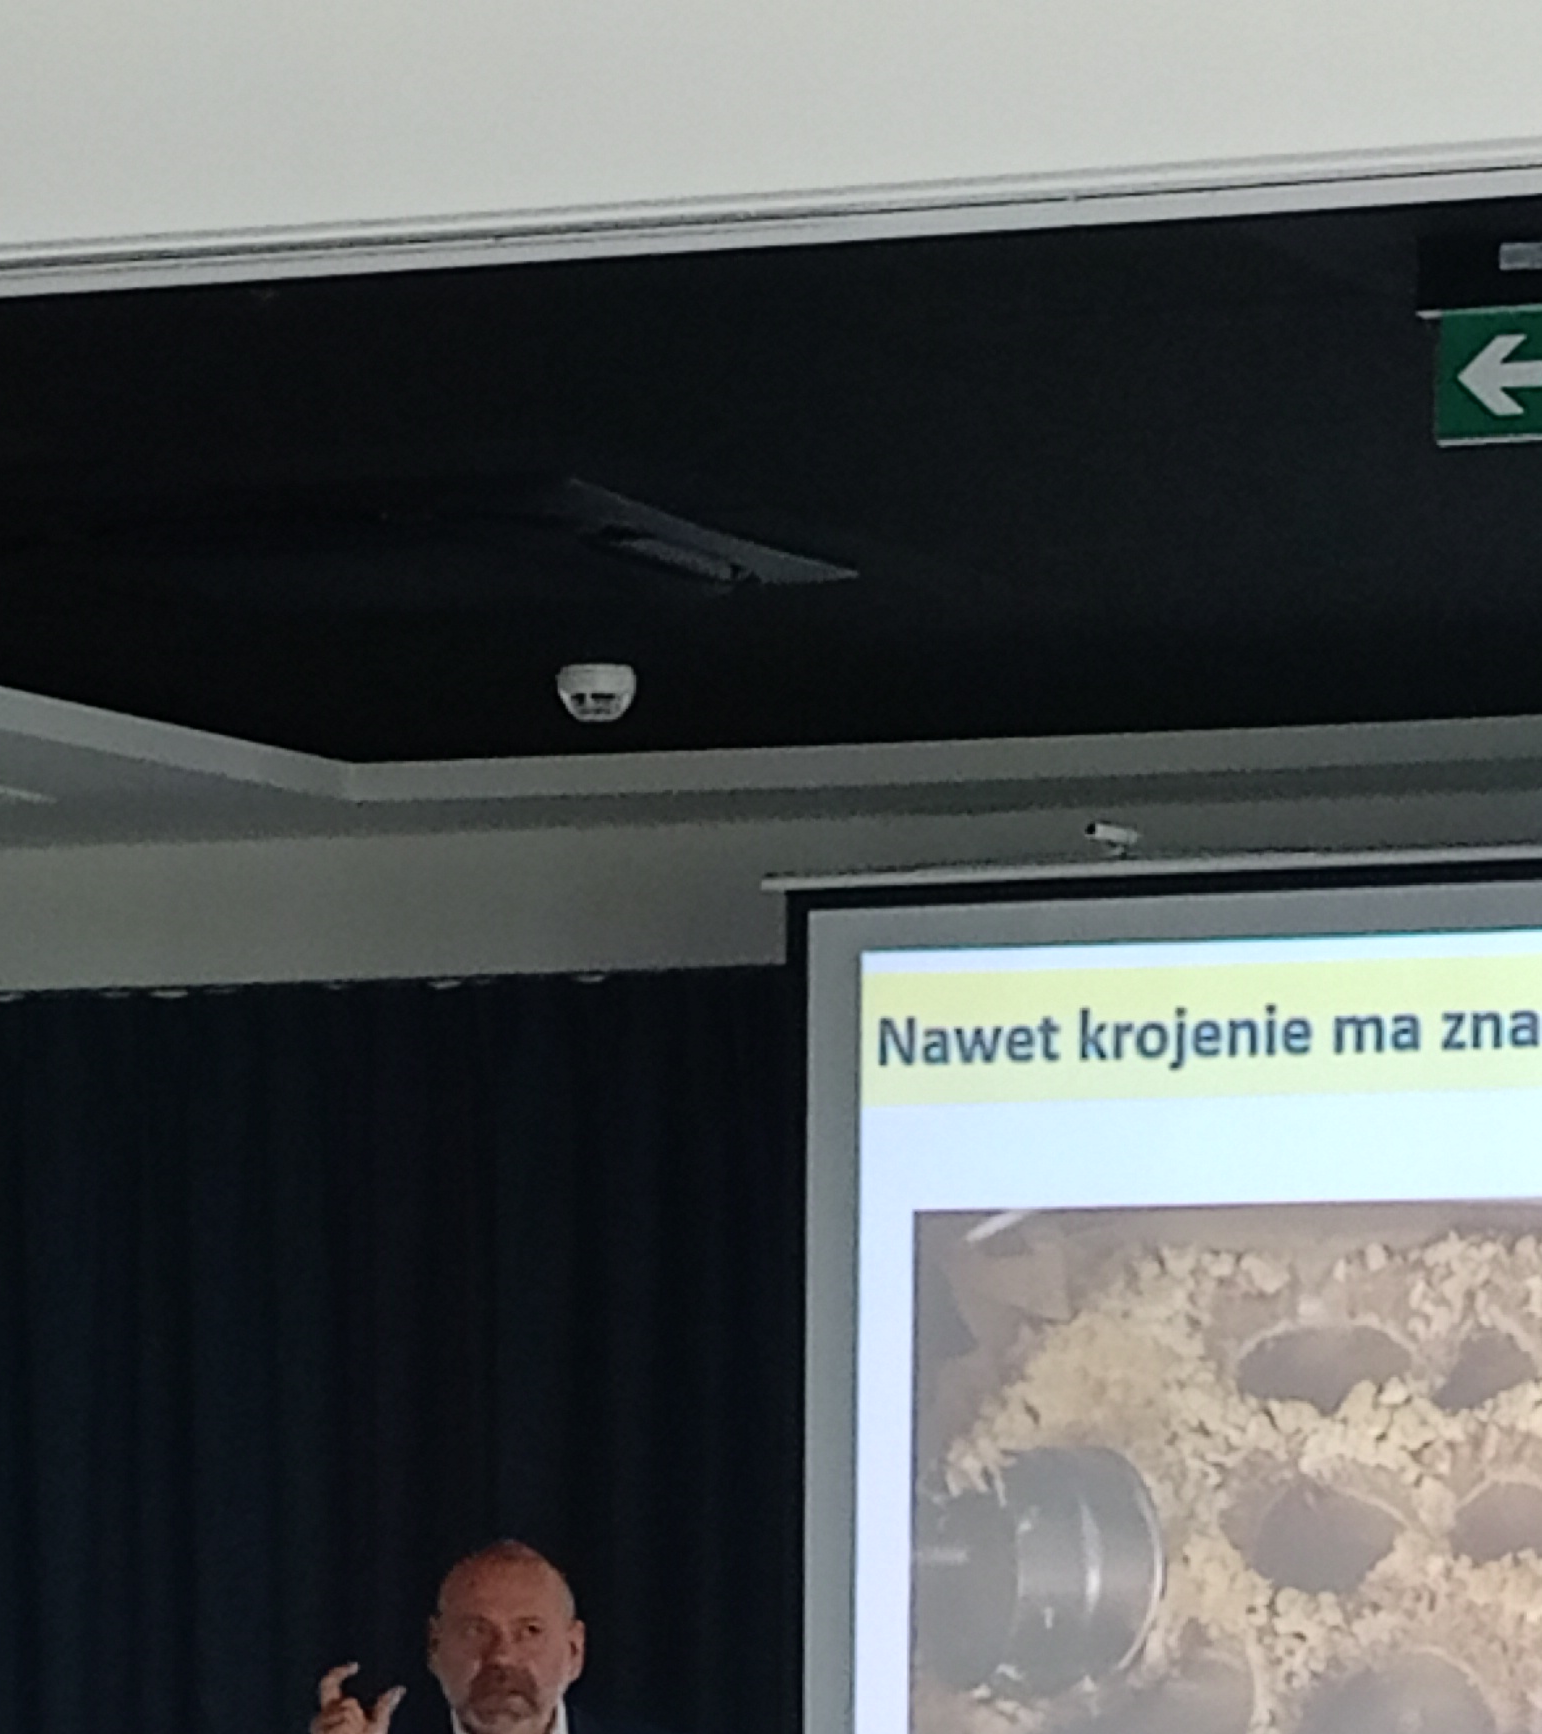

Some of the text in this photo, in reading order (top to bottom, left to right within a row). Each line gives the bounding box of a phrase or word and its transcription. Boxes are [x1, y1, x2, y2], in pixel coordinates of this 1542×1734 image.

[878, 1013, 1059, 1066] Nawet
[1081, 1005, 1311, 1069] krojenie
[1335, 1011, 1421, 1054] ma
